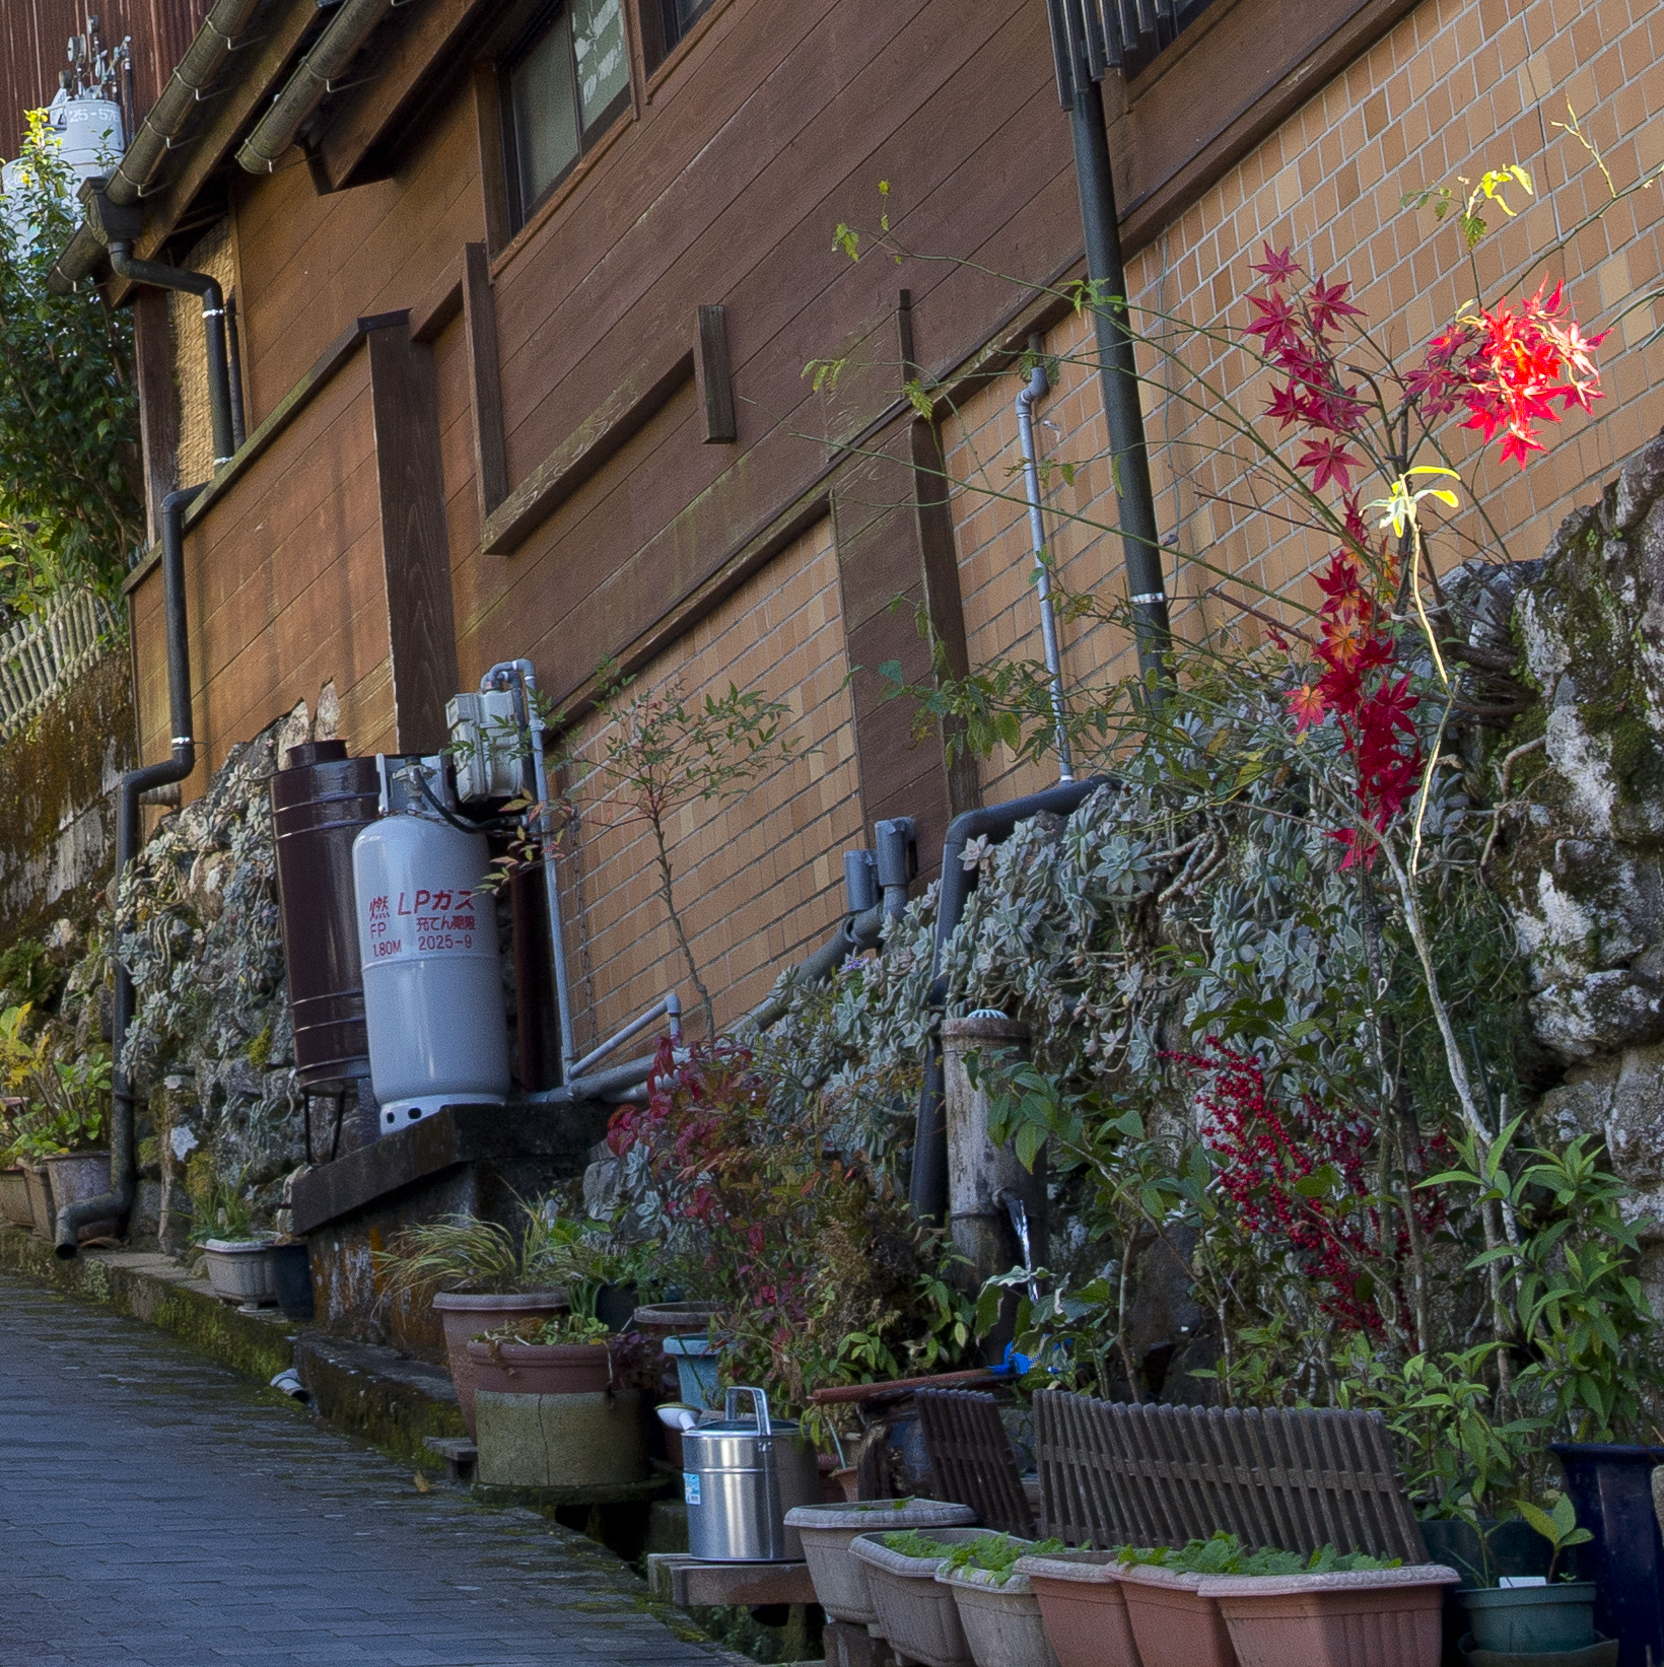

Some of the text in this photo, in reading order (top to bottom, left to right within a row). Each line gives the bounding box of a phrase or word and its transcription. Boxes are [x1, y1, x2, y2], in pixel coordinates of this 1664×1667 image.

[398, 889, 475, 916] LPガス
[370, 921, 387, 940] FP
[418, 934, 472, 951] 2025-9
